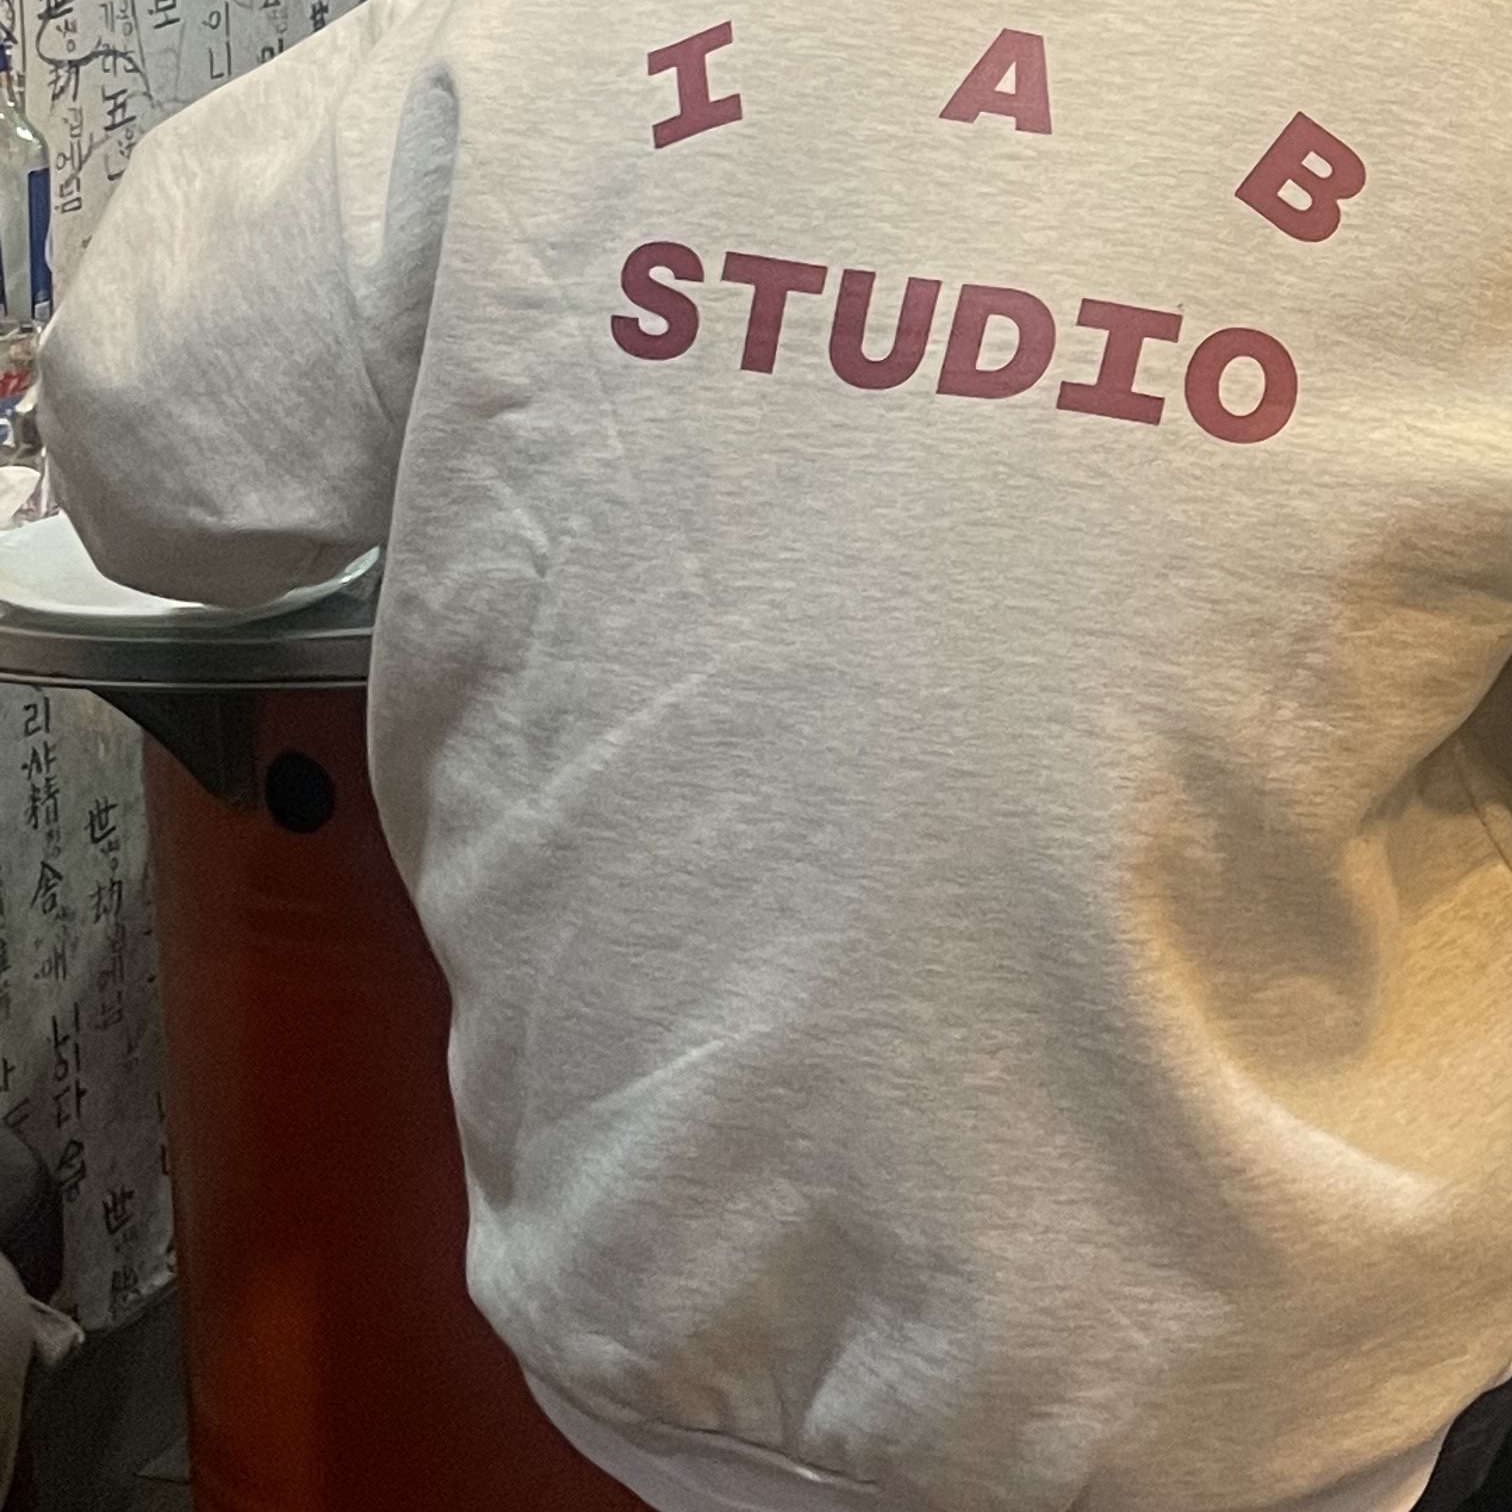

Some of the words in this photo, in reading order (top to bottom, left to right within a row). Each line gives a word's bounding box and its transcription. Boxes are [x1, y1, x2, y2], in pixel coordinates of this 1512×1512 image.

[647, 19, 743, 149] I
[938, 27, 1053, 136] A
[1234, 110, 1367, 243] B
[610, 240, 1298, 445] STUDIO
